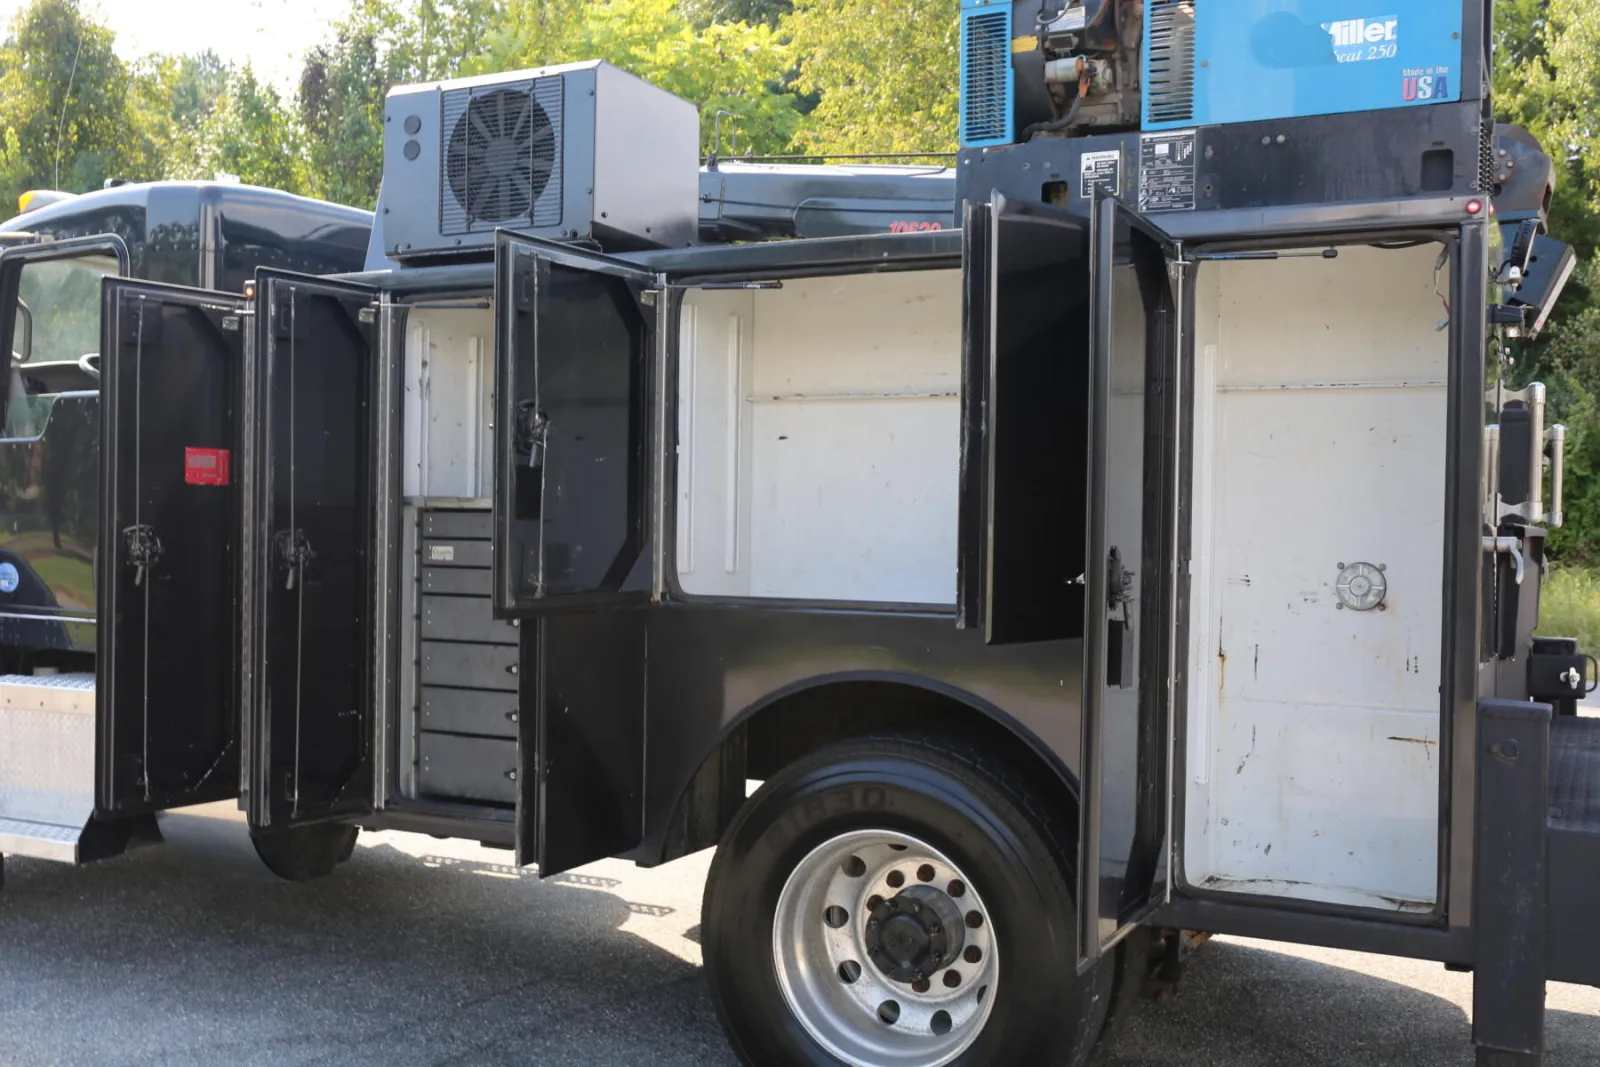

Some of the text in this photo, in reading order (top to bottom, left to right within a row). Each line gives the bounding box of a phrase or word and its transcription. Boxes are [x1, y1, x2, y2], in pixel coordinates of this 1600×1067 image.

[1367, 43, 1397, 60] 250
[1402, 68, 1425, 77] Made
[1436, 65, 1449, 74] the
[1402, 76, 1448, 101] USA
